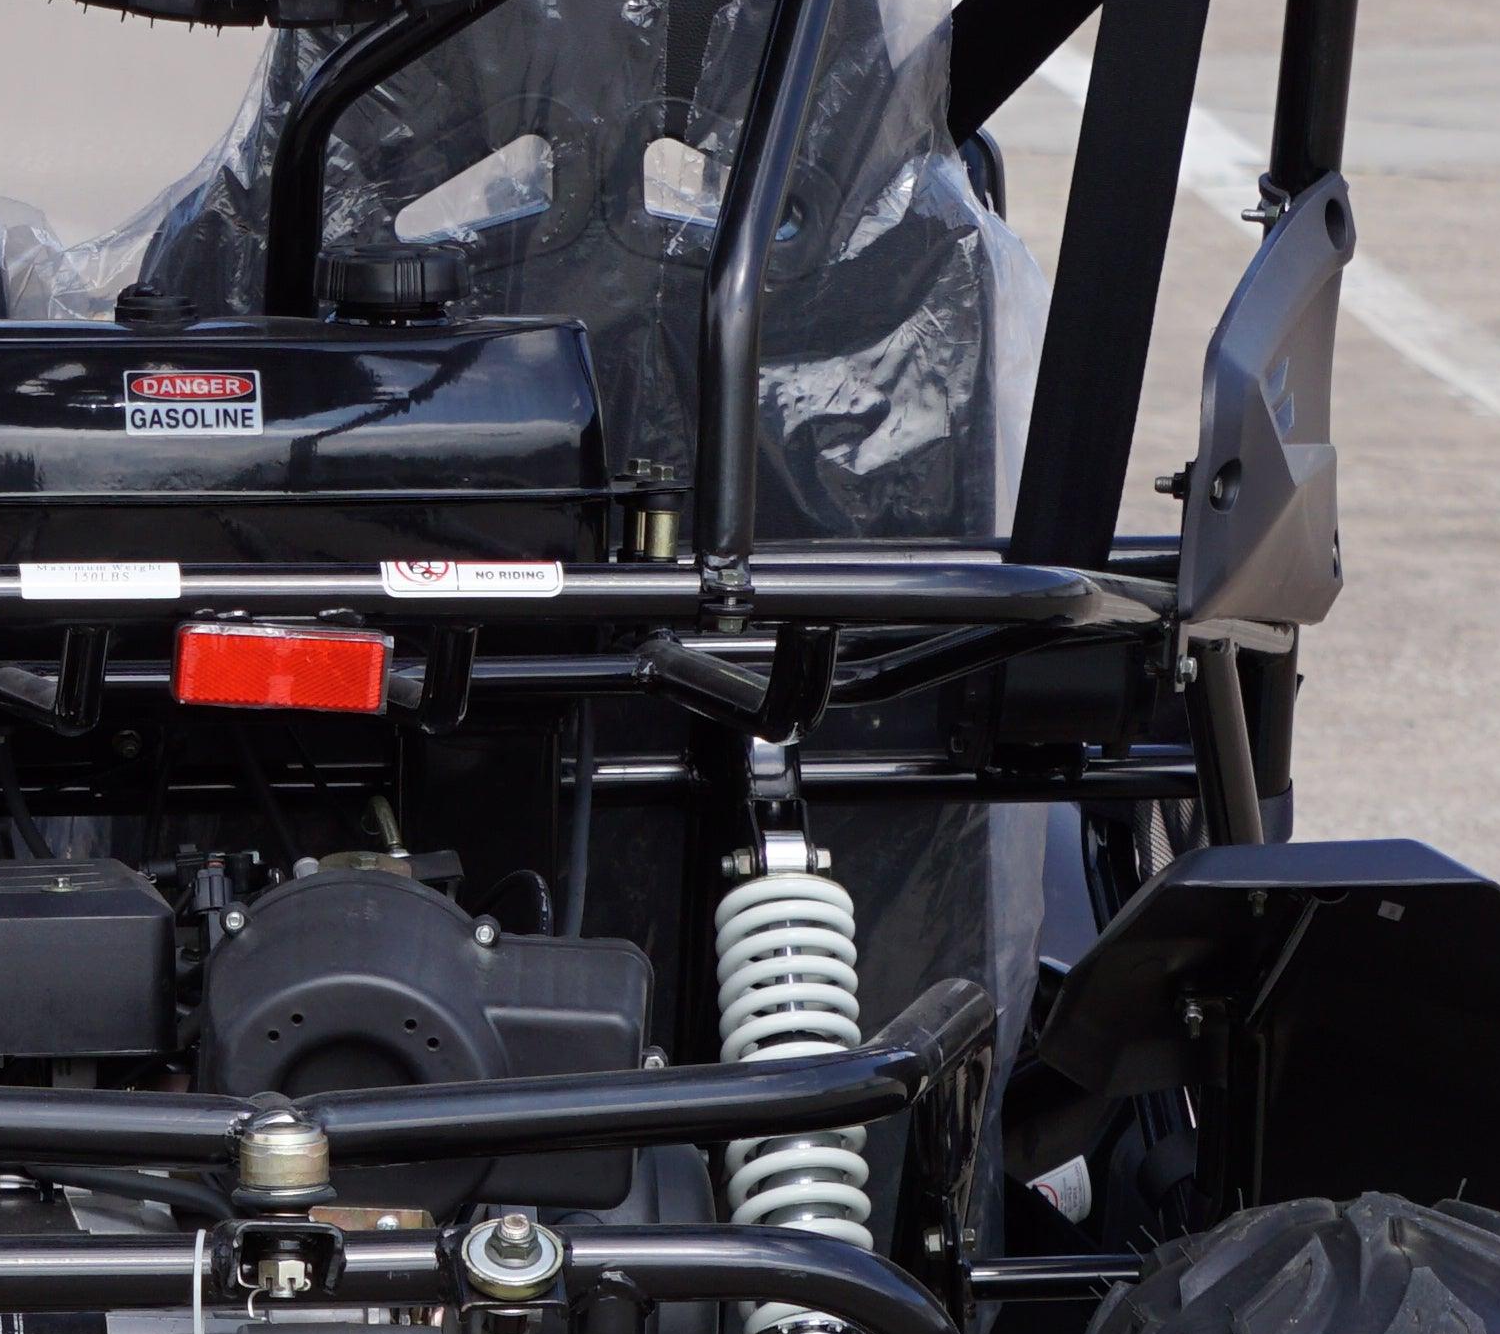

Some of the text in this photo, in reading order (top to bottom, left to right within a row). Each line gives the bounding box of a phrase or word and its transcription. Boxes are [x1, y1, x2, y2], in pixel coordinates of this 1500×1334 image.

[142, 378, 242, 395] DANGER
[130, 408, 255, 429] GASOLINE
[475, 571, 546, 580] NO RIDING
